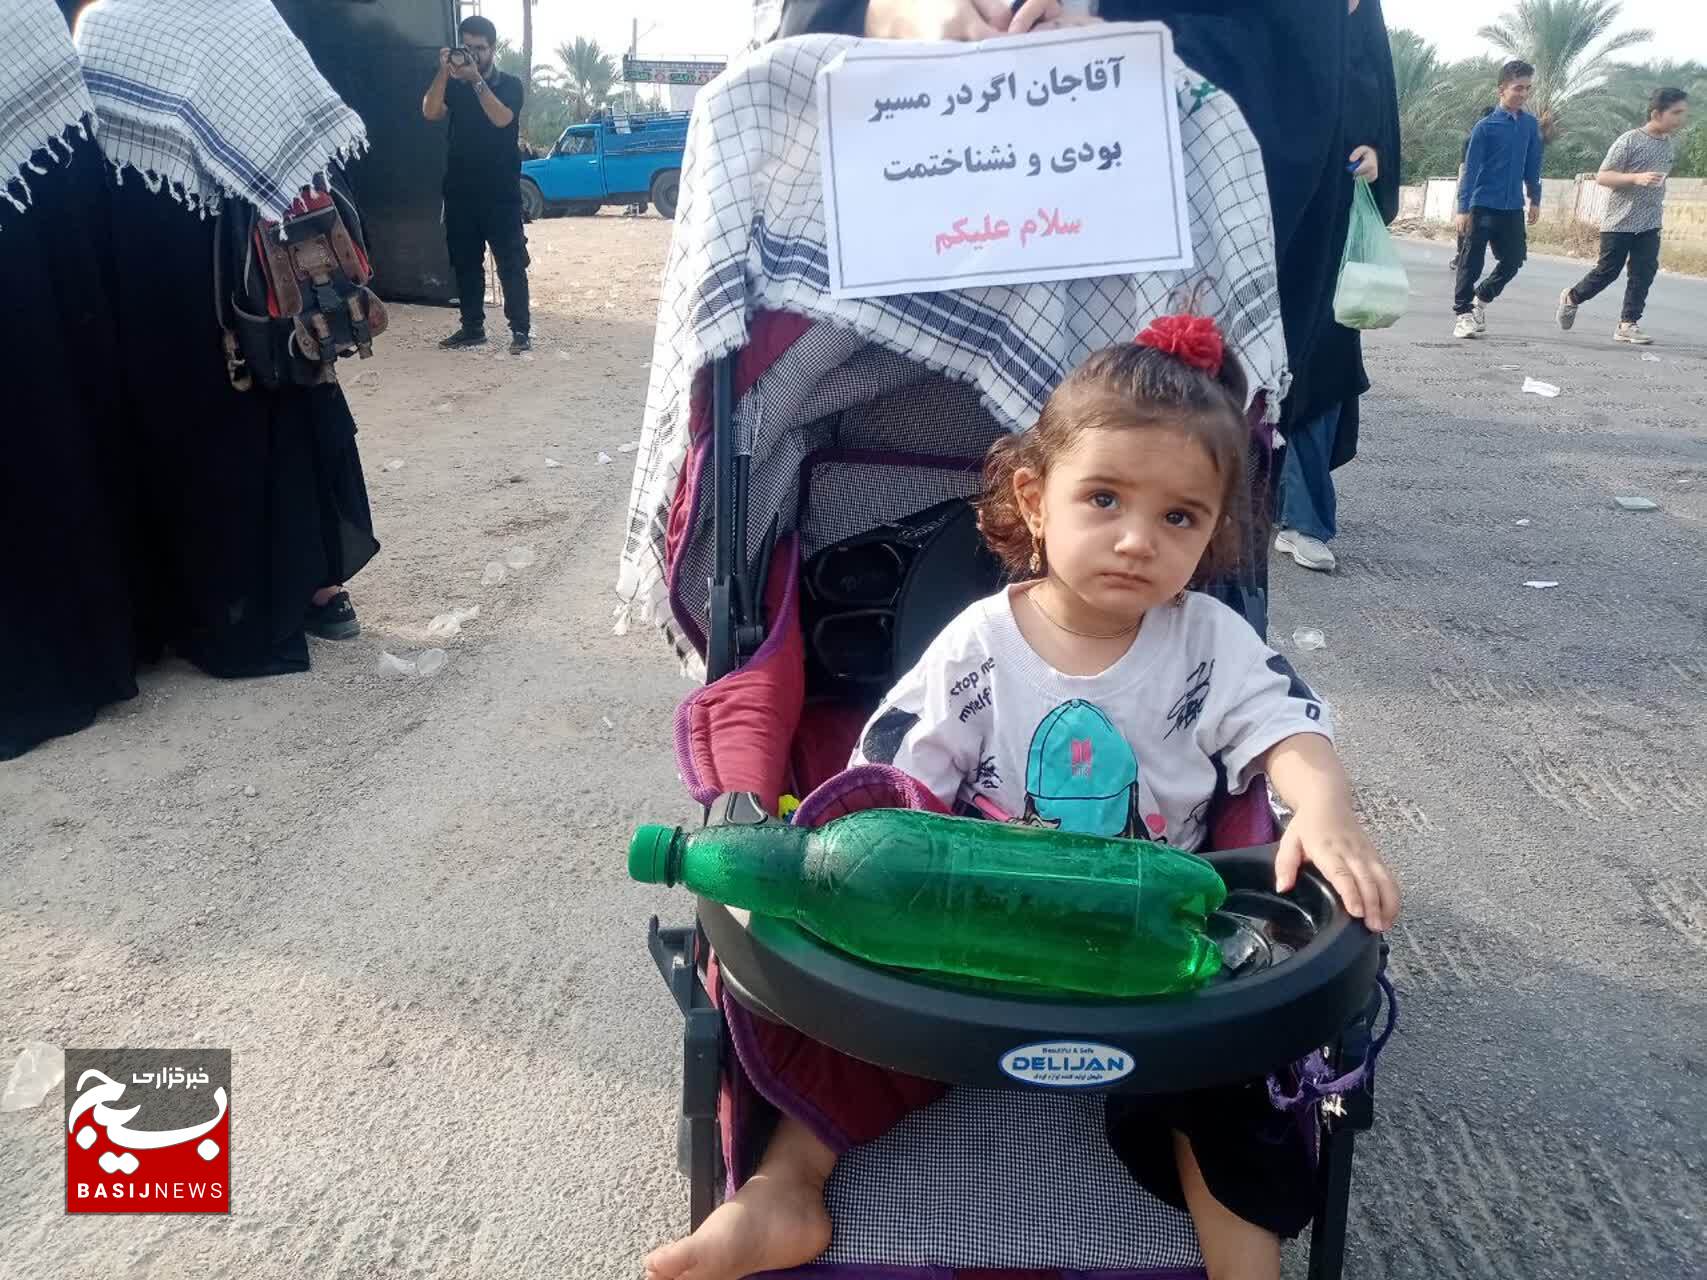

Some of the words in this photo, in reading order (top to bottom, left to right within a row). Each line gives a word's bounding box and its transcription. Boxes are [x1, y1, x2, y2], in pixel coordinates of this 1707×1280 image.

[941, 82, 973, 116] در
[976, 72, 1016, 112] اگر
[1026, 56, 1125, 107] آقاجان
[868, 92, 931, 123] مسیر
[883, 142, 1017, 182] نشناختمت
[1026, 152, 1041, 177] و
[1051, 141, 1122, 174] بودی
[936, 214, 1010, 255] علیکم
[1020, 207, 1082, 248] سلام
[1012, 1056, 1124, 1071] DELIJAN
